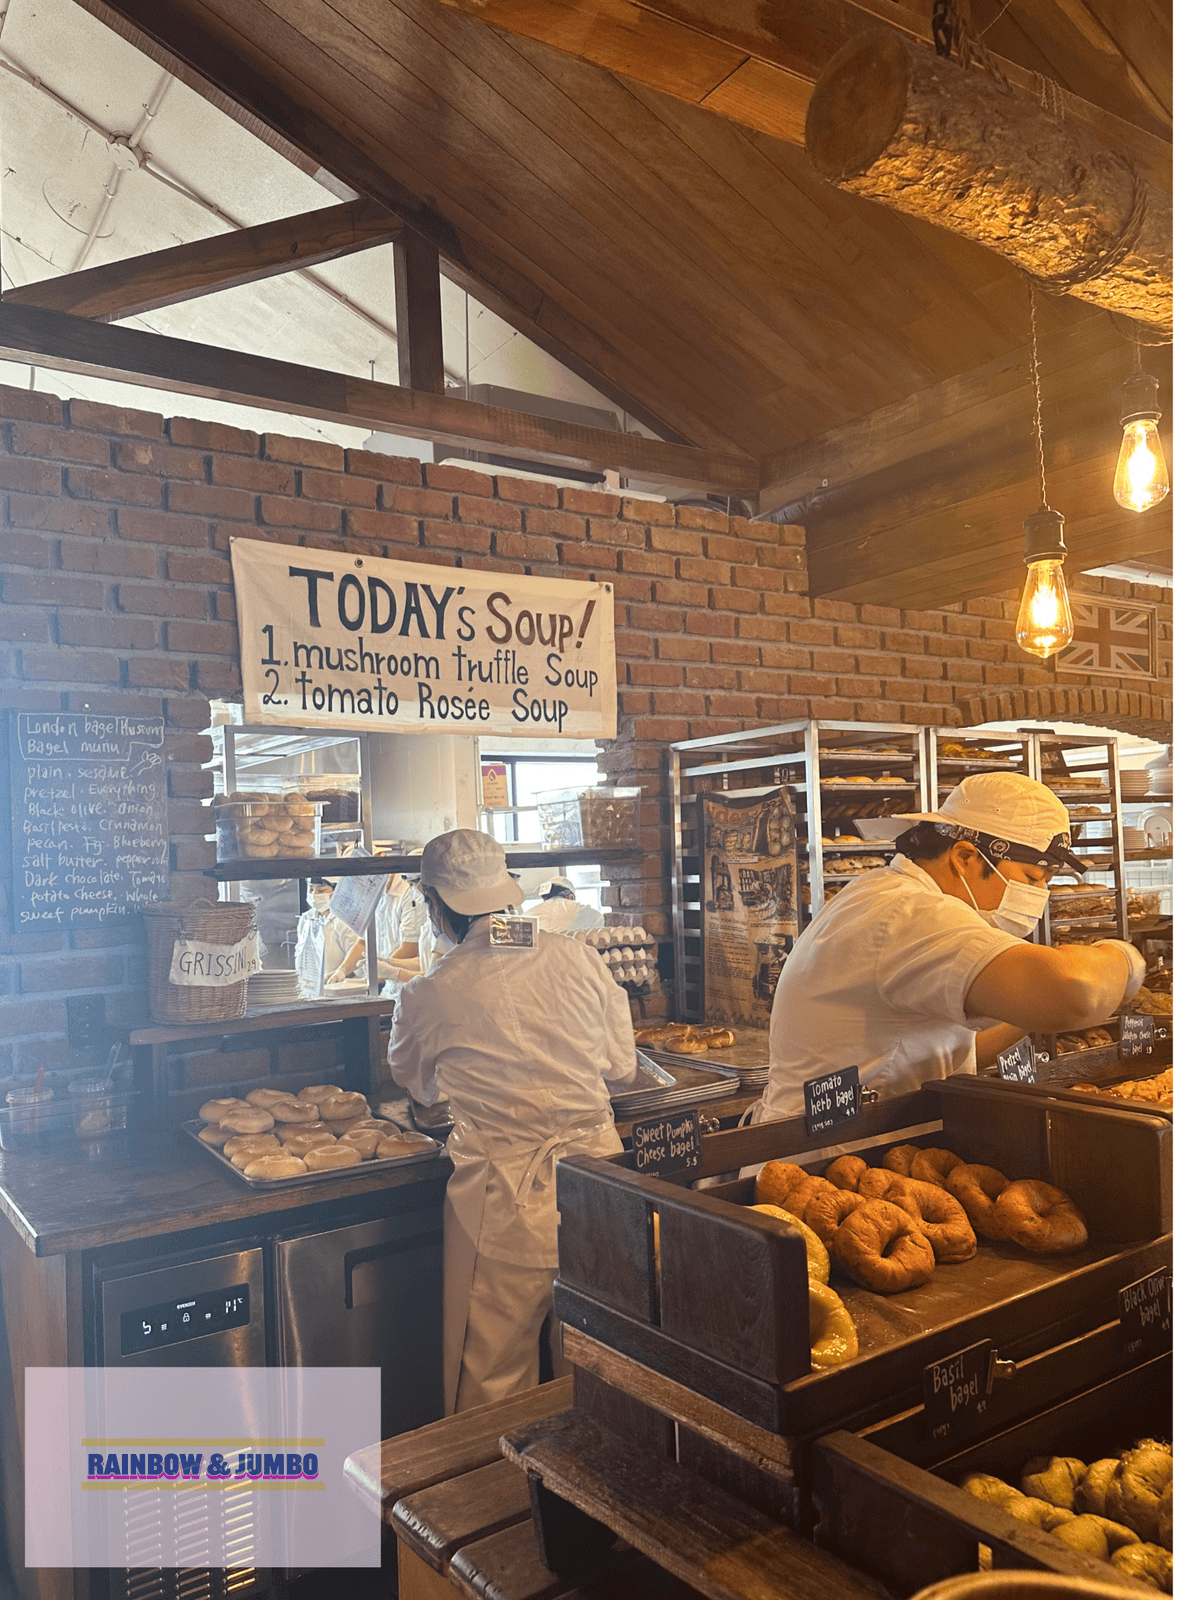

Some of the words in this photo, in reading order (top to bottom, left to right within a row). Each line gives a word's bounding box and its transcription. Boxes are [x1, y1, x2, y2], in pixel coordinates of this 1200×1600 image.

[289, 565, 475, 641] TODAY's
[486, 592, 597, 653] Soup!
[293, 636, 440, 680] mushroom
[452, 644, 529, 686] truffle
[295, 670, 399, 716] tomato
[419, 681, 490, 721] Rosée
[26, 716, 79, 737] London
[84, 715, 118, 739] bagel
[27, 738, 69, 756] Bagel
[22, 853, 52, 870] salt
[24, 870, 58, 888] Dark
[31, 889, 70, 908] potato
[179, 946, 247, 977] GRISSINI
[808, 1074, 842, 1098] Tomato
[810, 1093, 832, 1117] herb
[835, 1085, 855, 1108] bagel
[635, 1122, 665, 1148] Sweet
[636, 1146, 666, 1168] Cheese
[670, 1135, 695, 1158] bagel
[1139, 1298, 1161, 1327] bagel
[933, 1354, 964, 1394] Basil
[949, 1373, 978, 1413] bagel
